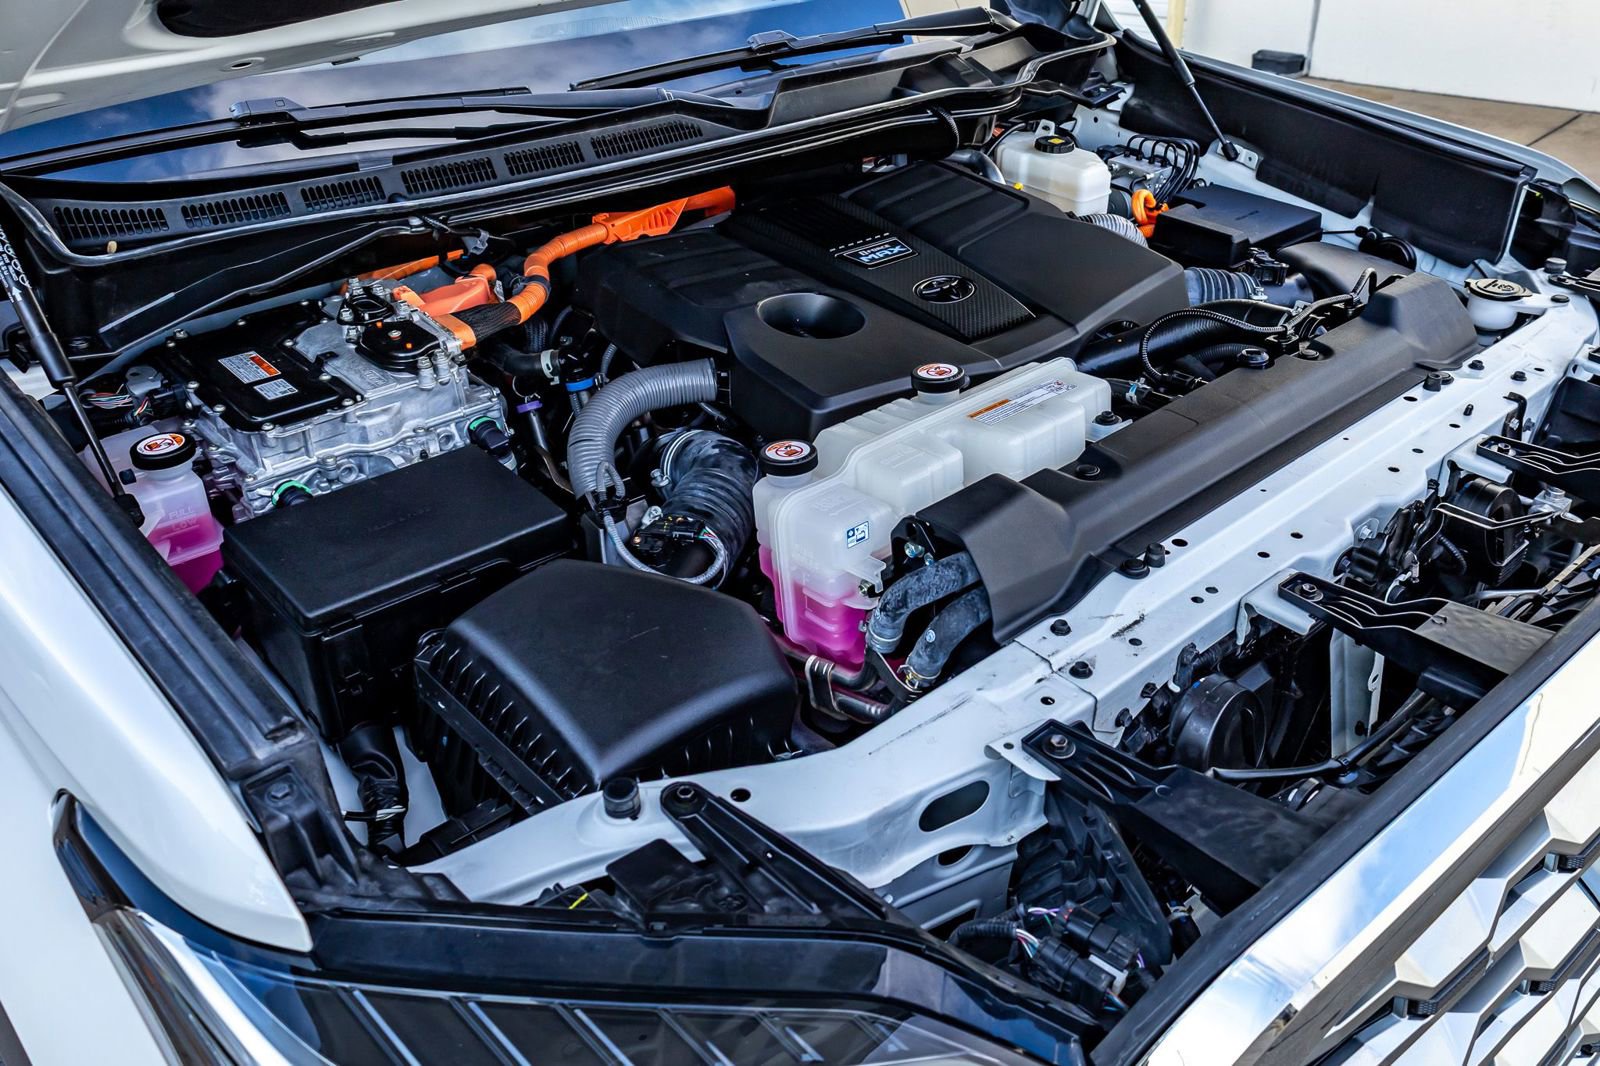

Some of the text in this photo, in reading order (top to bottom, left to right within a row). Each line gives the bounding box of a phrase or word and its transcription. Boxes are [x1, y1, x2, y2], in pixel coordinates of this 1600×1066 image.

[859, 245, 907, 262] MAX
[168, 505, 195, 520] FULL
[172, 517, 197, 531] LOW
